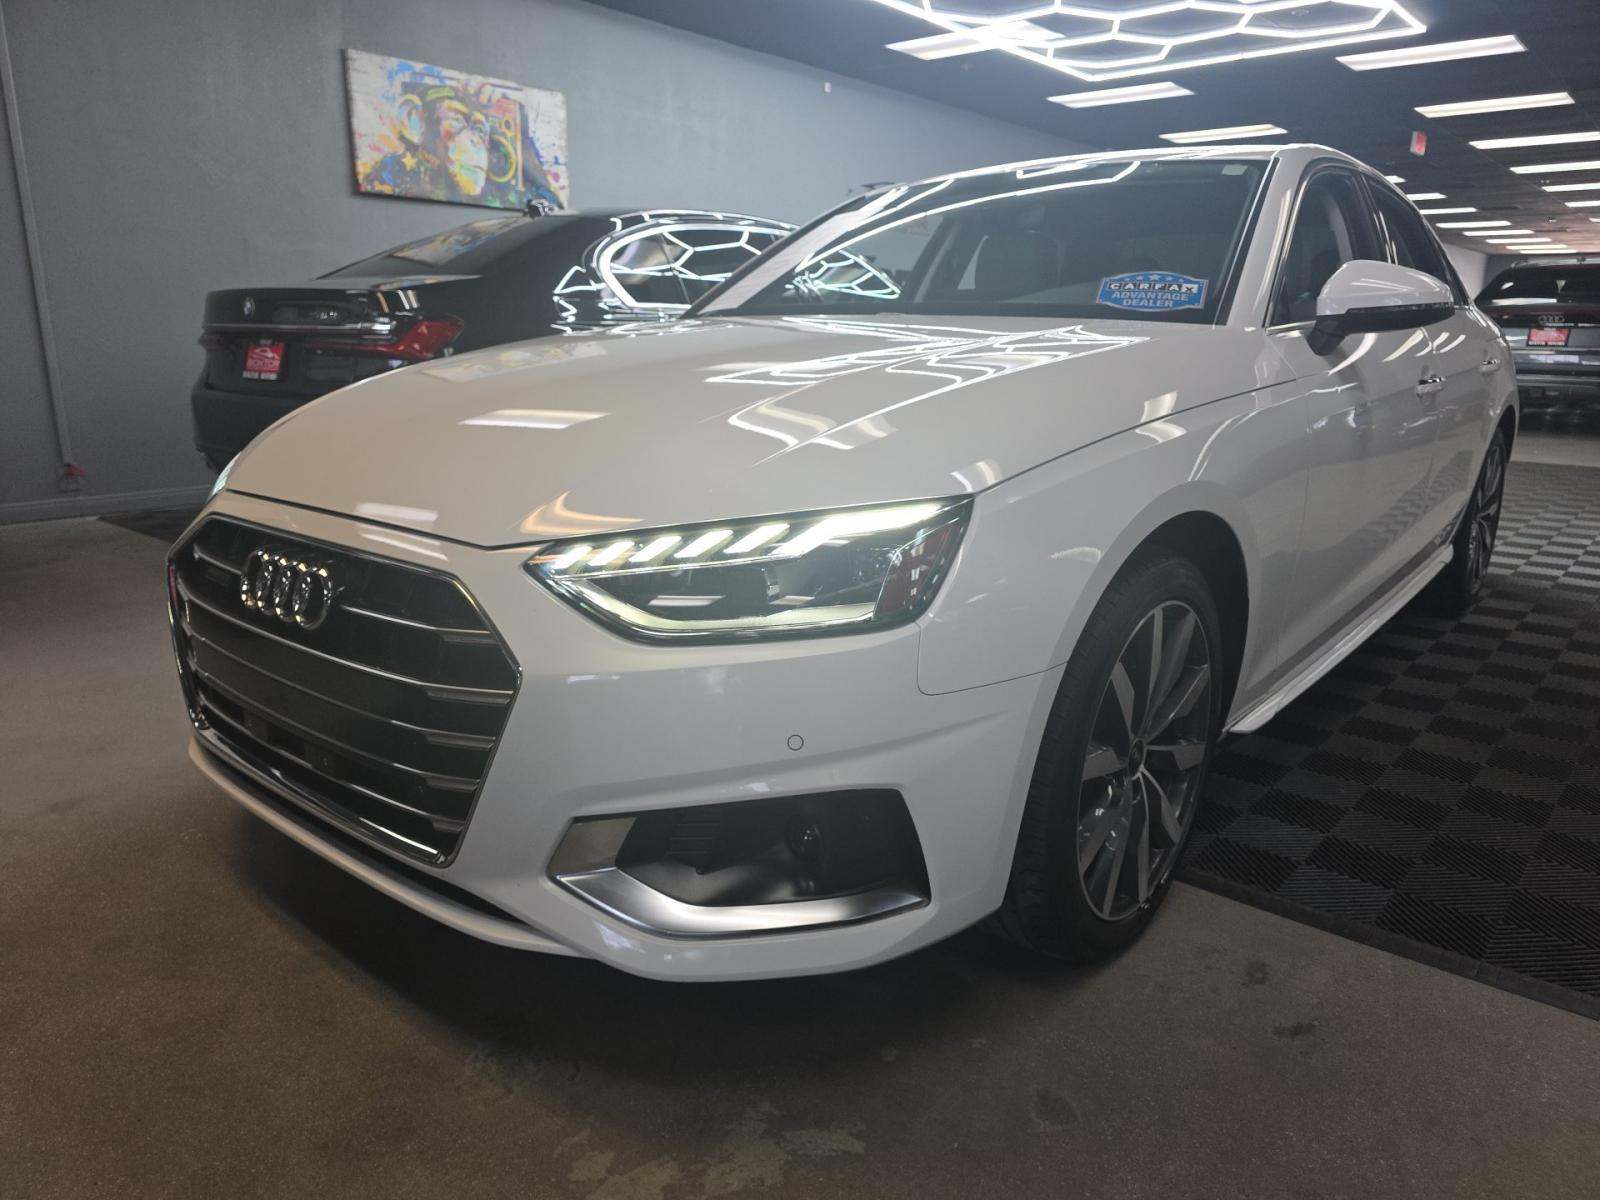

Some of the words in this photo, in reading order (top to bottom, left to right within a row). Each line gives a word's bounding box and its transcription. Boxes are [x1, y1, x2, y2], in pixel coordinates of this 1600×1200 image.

[1108, 282, 1199, 294] CARFAX
[1111, 291, 1188, 301] ADVANTAGE
[1123, 299, 1174, 307] DEALER
